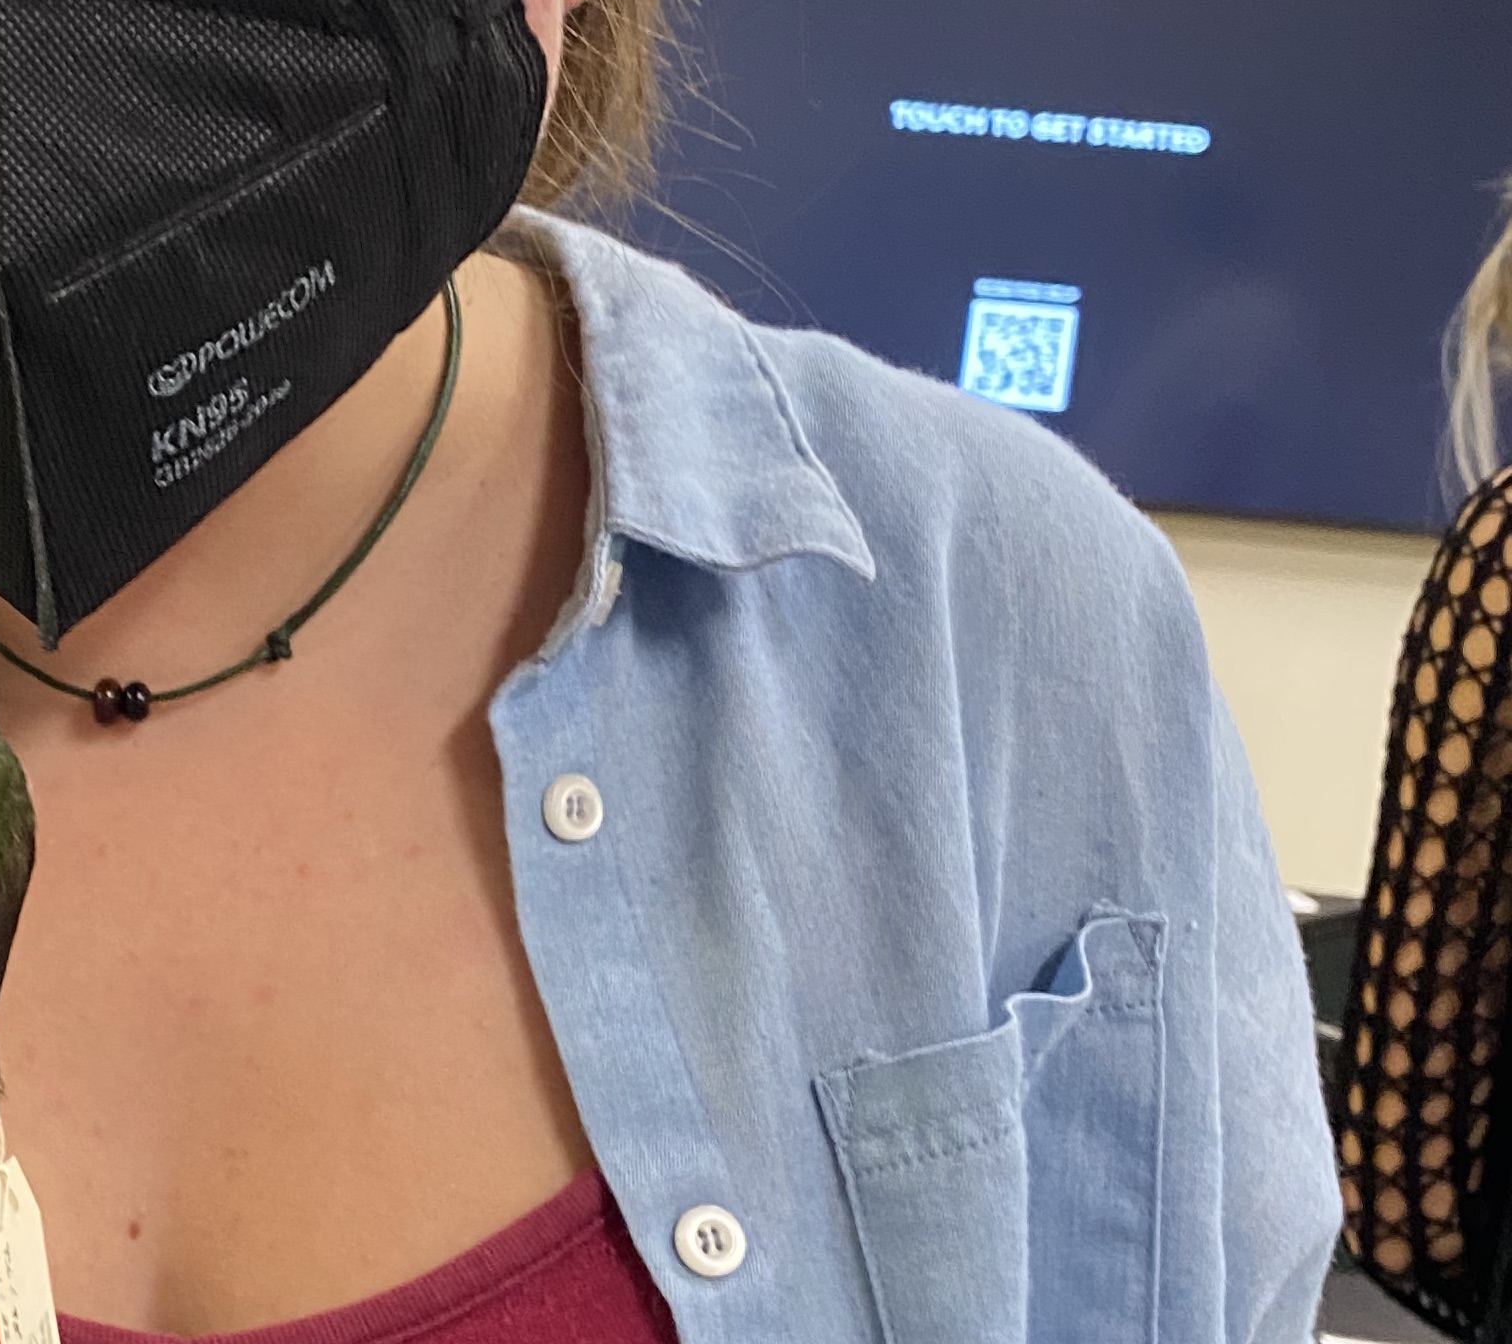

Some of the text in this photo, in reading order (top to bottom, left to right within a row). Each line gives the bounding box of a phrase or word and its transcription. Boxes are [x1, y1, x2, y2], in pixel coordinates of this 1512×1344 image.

[890, 99, 1211, 156] TOUCH TO GET STARTED
[152, 376, 248, 464] KN95
